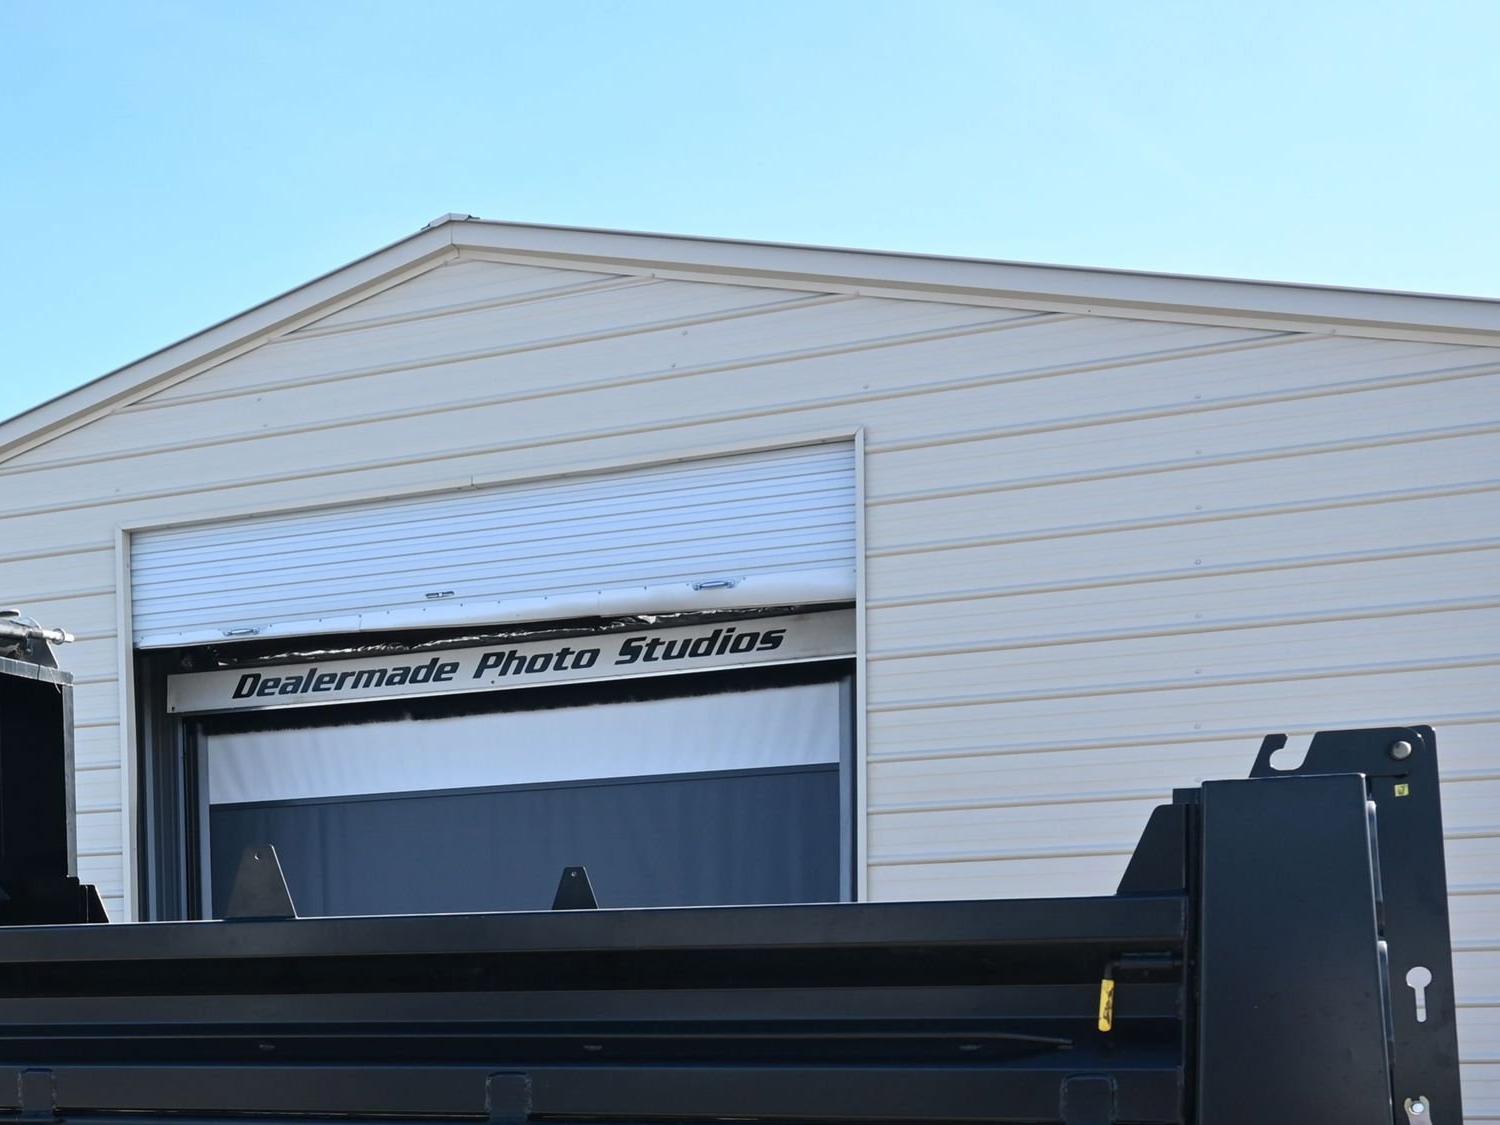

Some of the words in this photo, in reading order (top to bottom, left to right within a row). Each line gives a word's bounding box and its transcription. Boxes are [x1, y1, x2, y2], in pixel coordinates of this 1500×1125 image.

[232, 658, 460, 699] Dealermade
[472, 647, 601, 679] Photo
[614, 627, 787, 665] Studios
